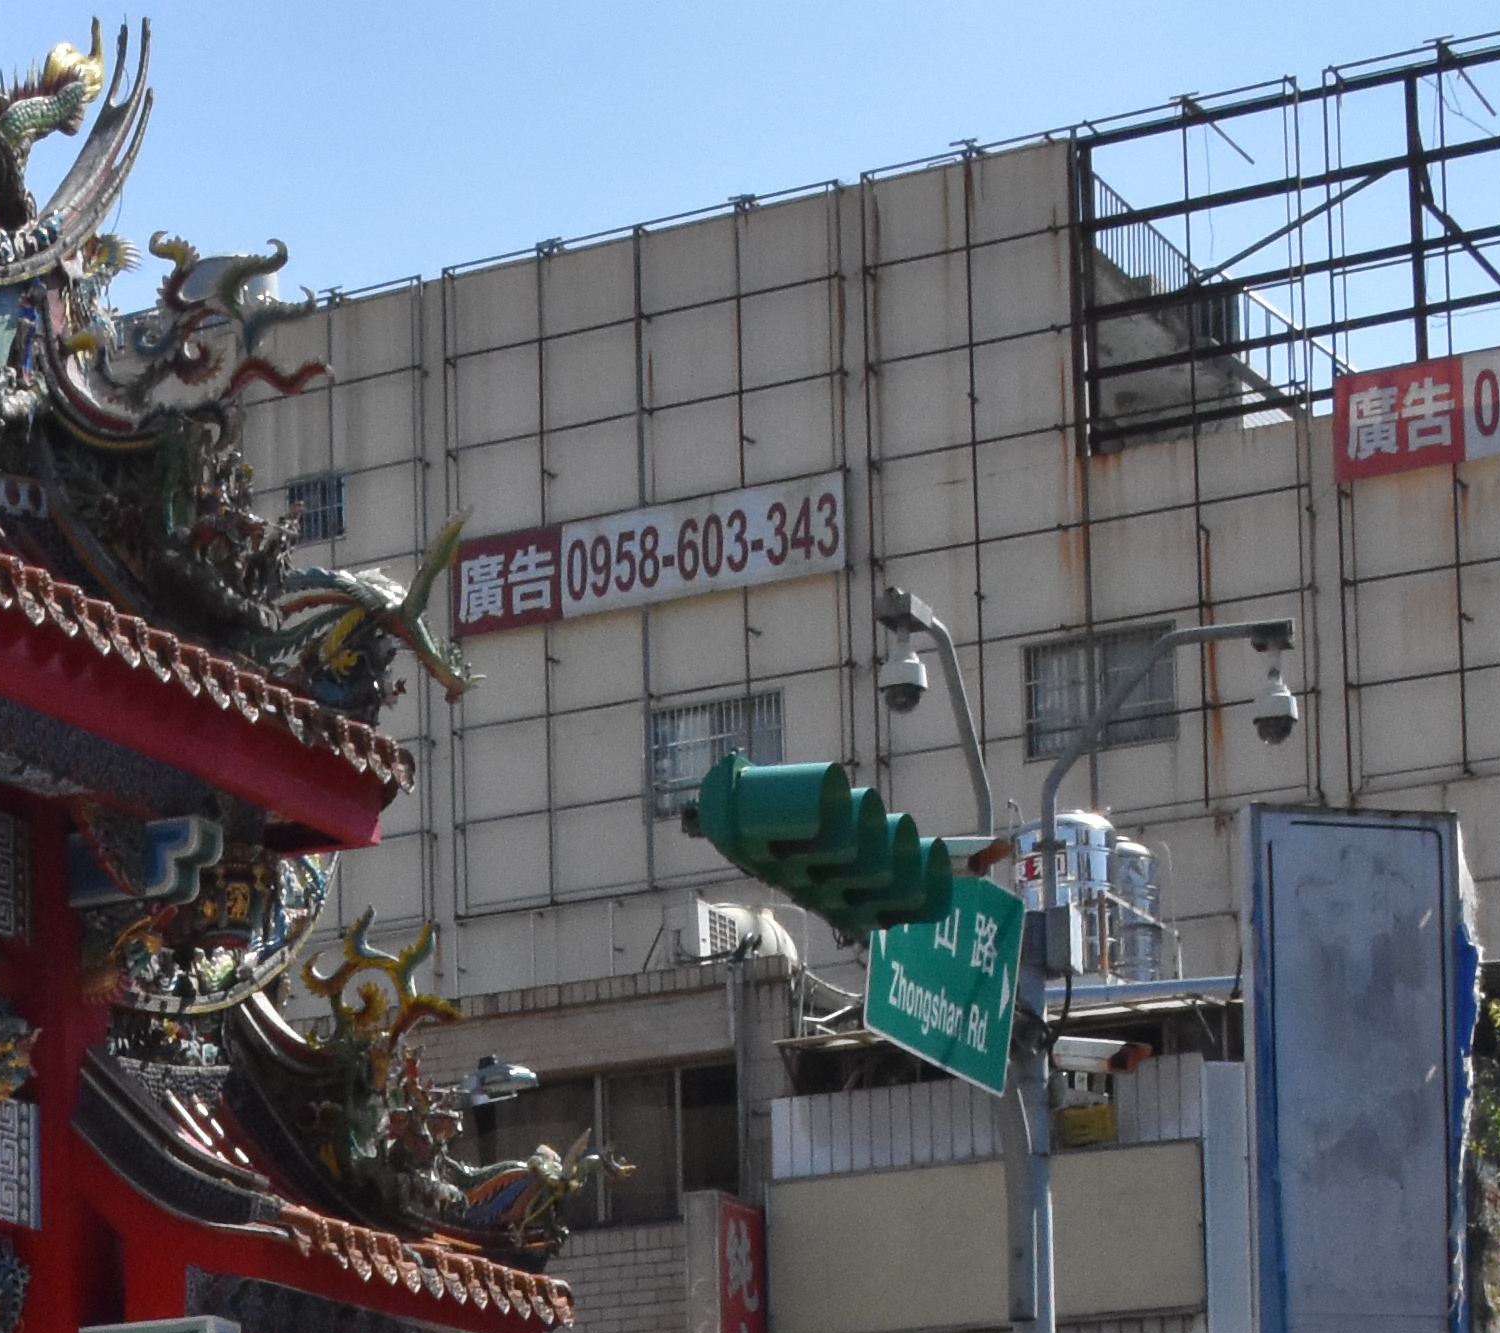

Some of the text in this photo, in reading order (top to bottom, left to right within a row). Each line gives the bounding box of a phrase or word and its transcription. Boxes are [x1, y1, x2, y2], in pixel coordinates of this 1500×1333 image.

[1347, 376, 1454, 460] 廣告
[458, 492, 840, 623] 廣告 0958-603-343
[888, 960, 964, 1040] Zhongshan
